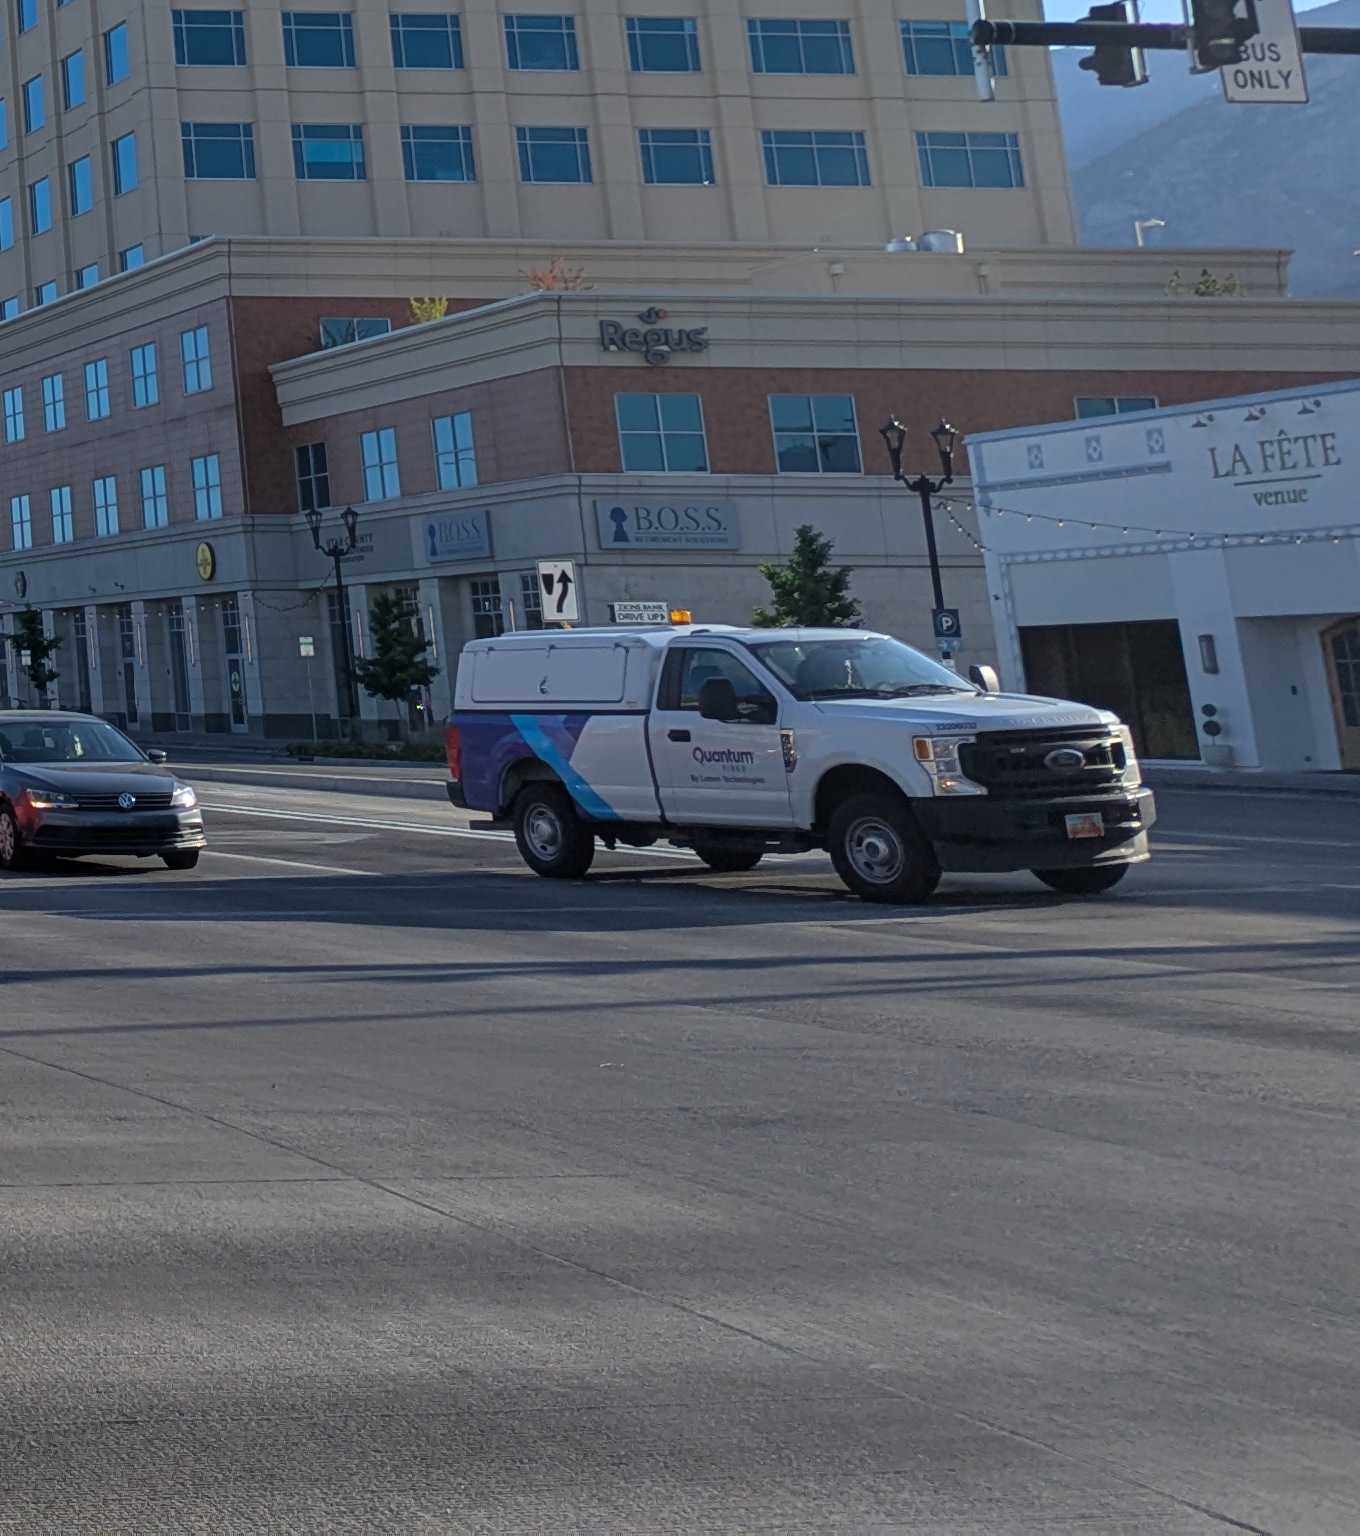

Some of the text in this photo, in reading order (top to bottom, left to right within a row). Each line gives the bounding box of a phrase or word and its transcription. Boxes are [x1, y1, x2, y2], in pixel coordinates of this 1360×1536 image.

[1239, 42, 1282, 62] BUS
[1233, 69, 1292, 90] ONLY
[598, 319, 710, 366] Regus
[1207, 428, 1342, 479] LA FÊTE
[1252, 488, 1309, 506] venue
[634, 506, 728, 531] B.O.S.S.
[618, 612, 660, 621] DRIVE UP
[942, 616, 952, 631] P
[692, 746, 754, 765] Quantum
